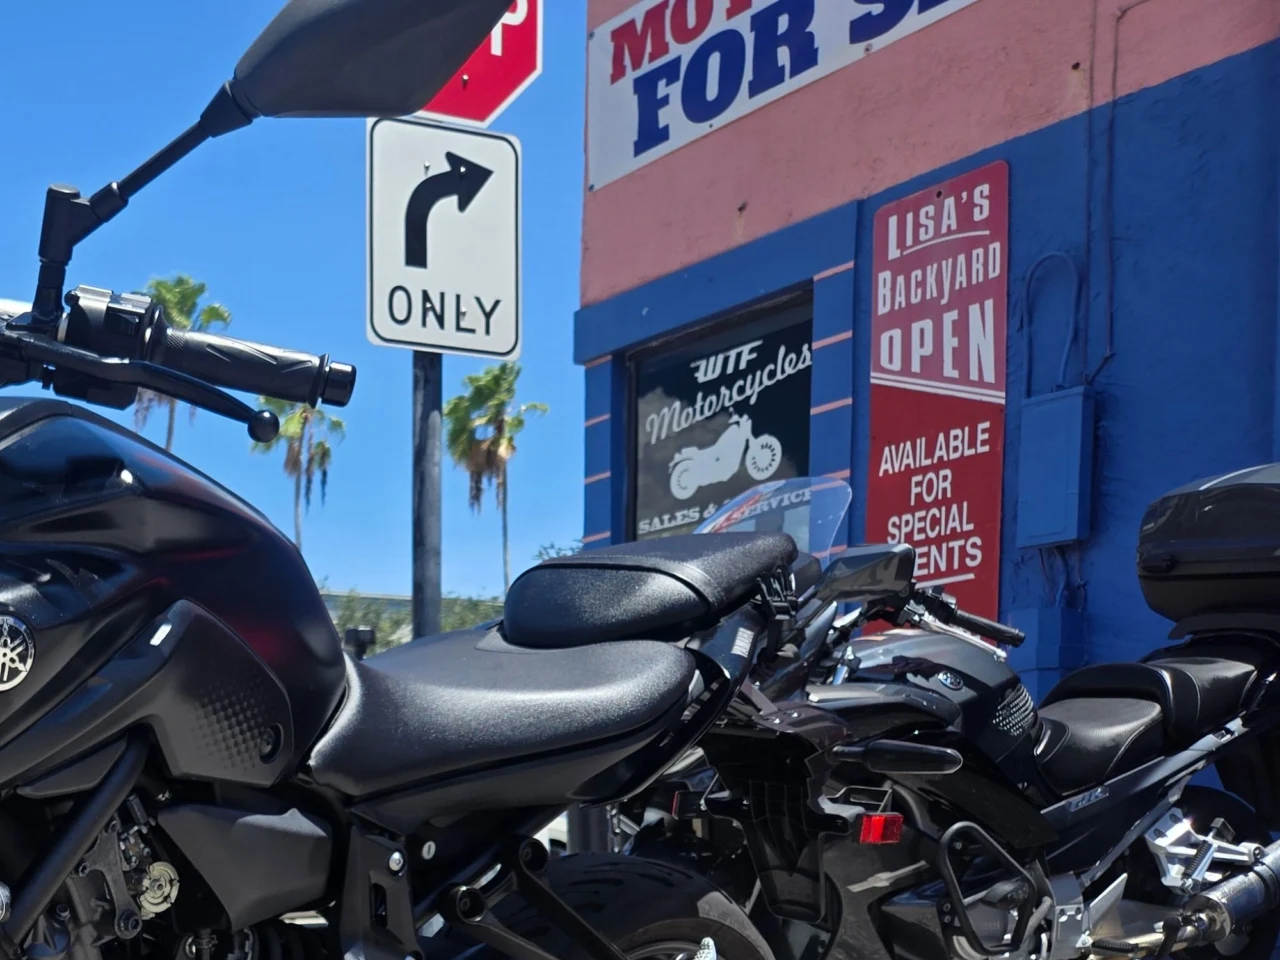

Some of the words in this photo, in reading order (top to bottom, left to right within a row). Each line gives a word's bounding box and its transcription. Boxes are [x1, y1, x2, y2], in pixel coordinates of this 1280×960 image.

[633, 0, 818, 158] FOR
[888, 184, 990, 261] LISA'S
[388, 285, 502, 336] ONLY
[690, 340, 763, 384] WTF
[880, 298, 996, 384] OPEN
[646, 343, 812, 445] Motorcycles
[878, 421, 991, 477] AVAILABLE
[638, 507, 701, 535] SALES
[703, 503, 719, 519] &
[726, 487, 812, 519] ERVICE
[910, 468, 952, 507] FOR
[887, 501, 974, 544] SPECIAL
[913, 536, 982, 577] ENTS
